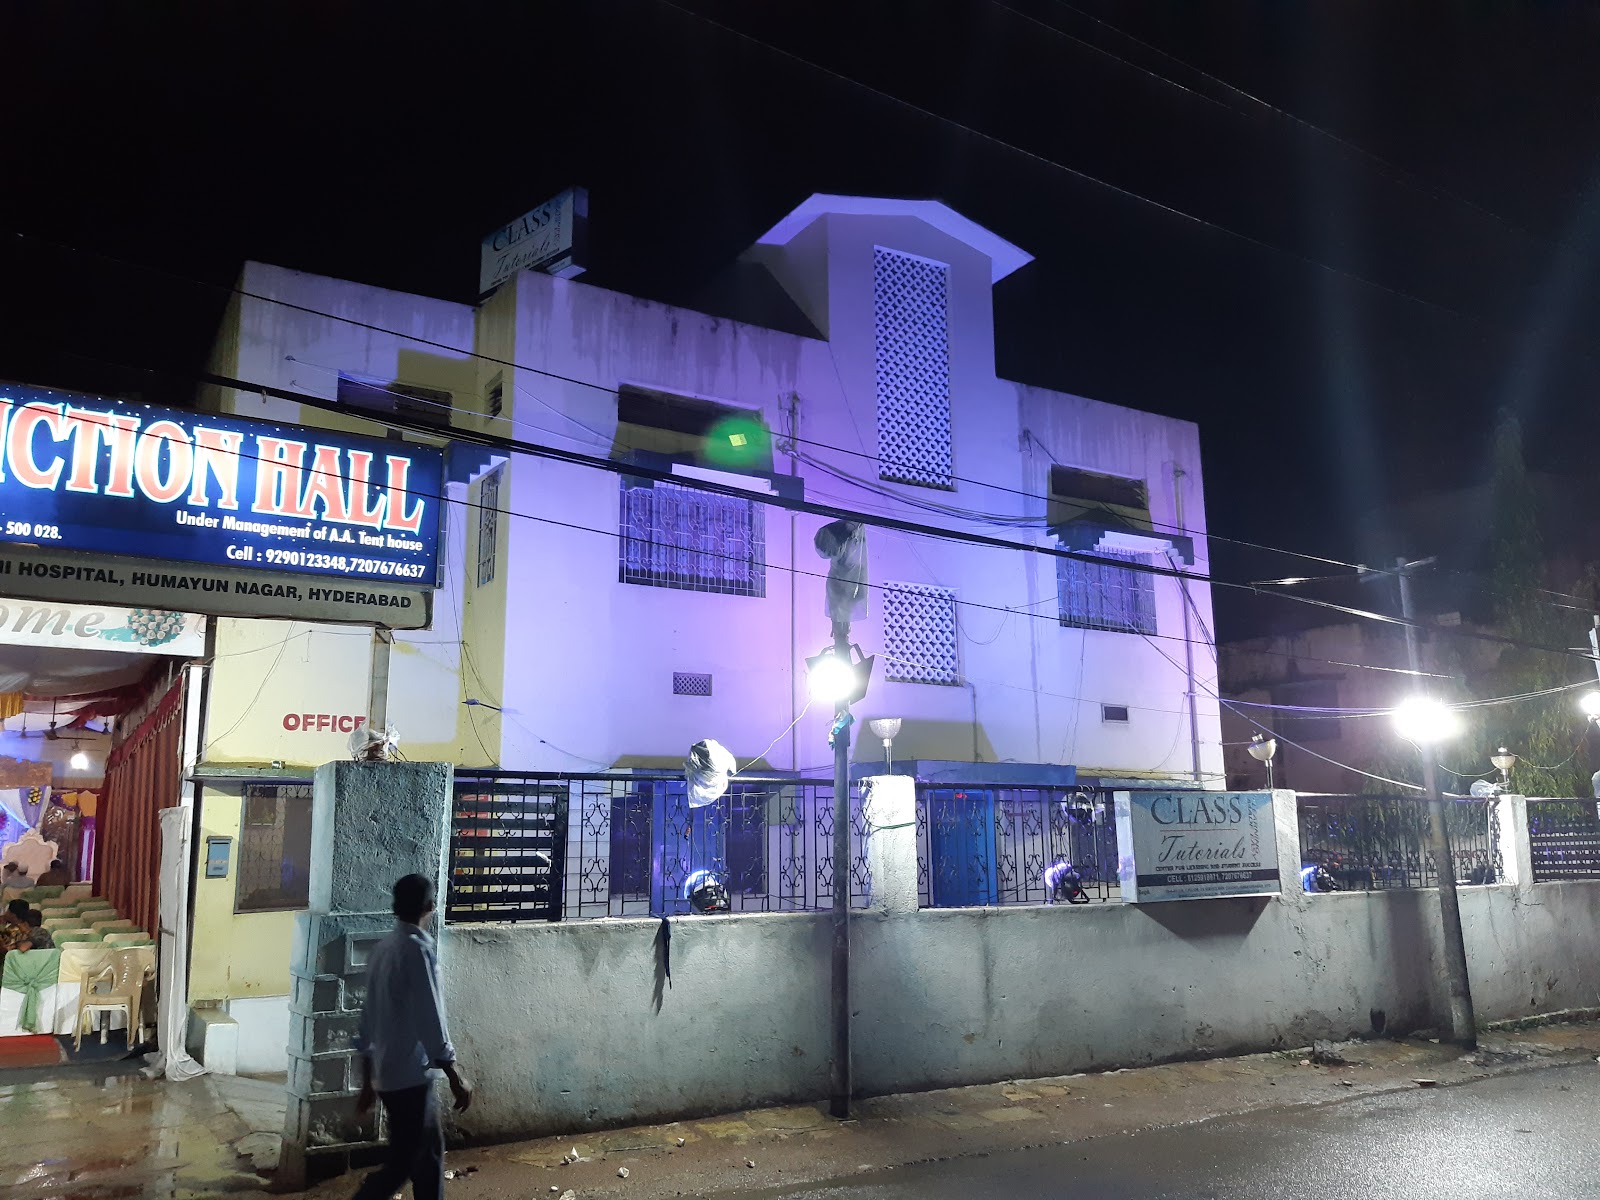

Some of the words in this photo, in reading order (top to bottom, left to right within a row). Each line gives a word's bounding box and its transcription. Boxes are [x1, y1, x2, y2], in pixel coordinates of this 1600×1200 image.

[0, 397, 243, 510] CTION
[251, 435, 425, 535] HALL
[6, 521, 31, 536] 500
[34, 523, 63, 540] 028.
[176, 510, 219, 528] Under
[222, 516, 310, 540] Management
[313, 528, 327, 541] of
[329, 529, 355, 545] A.A.
[358, 532, 385, 548] Tent
[387, 537, 423, 551] house
[226, 545, 253, 561] Cell
[266, 548, 425, 578] 9290123348,7207676637
[18, 562, 125, 587] HOSPITAL,
[132, 572, 229, 593] HUMAYUN
[235, 581, 302, 602] NAGAR,
[308, 587, 412, 609] HYDERABAD
[1158, 834, 1246, 863] Tutorials
[1167, 875, 1183, 883] CELL
